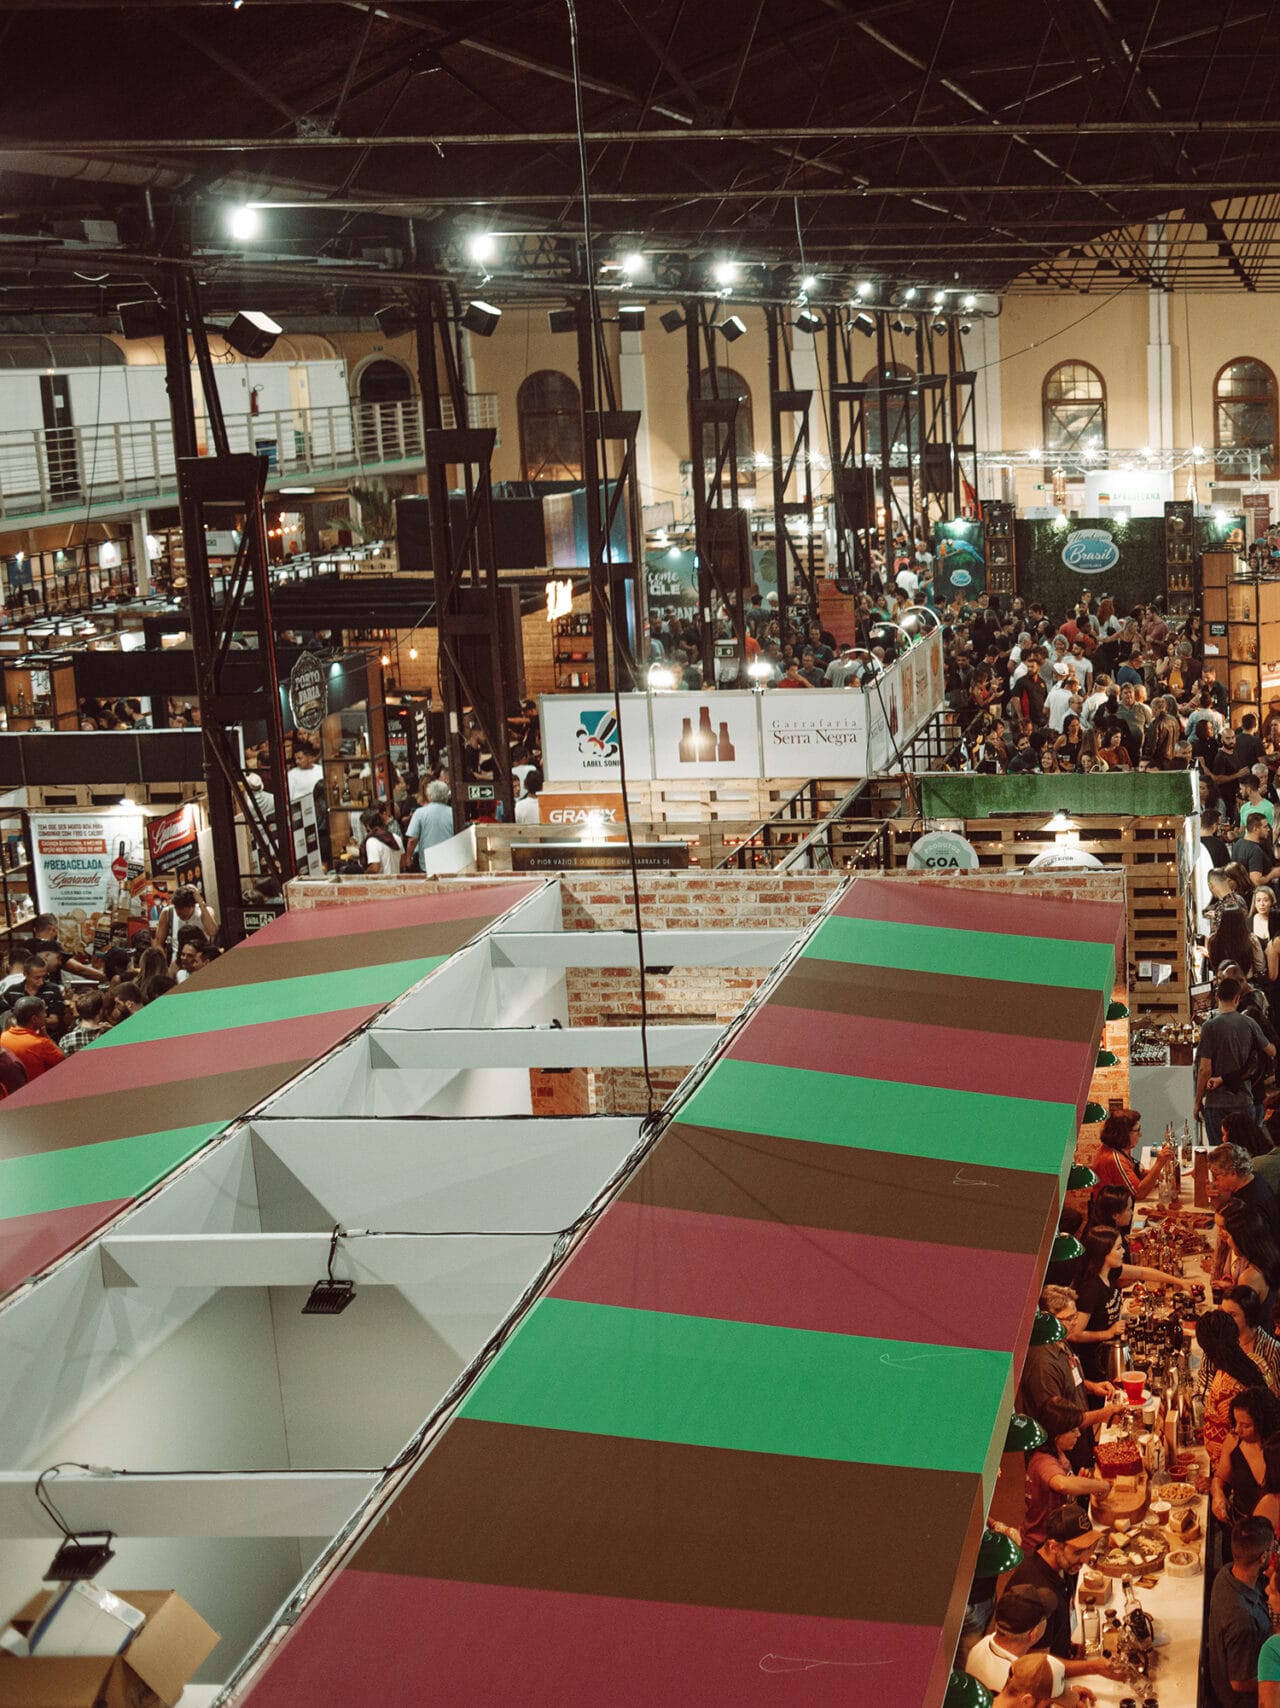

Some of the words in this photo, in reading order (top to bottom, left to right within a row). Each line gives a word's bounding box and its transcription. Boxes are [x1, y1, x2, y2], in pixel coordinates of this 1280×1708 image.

[1070, 543, 1113, 564] Brasil
[771, 719, 857, 729] Garrafaria
[773, 730, 811, 745] Serra
[815, 729, 858, 745] Negra
[43, 859, 104, 870] #BEBAGELADA
[925, 857, 960, 868] GOA
